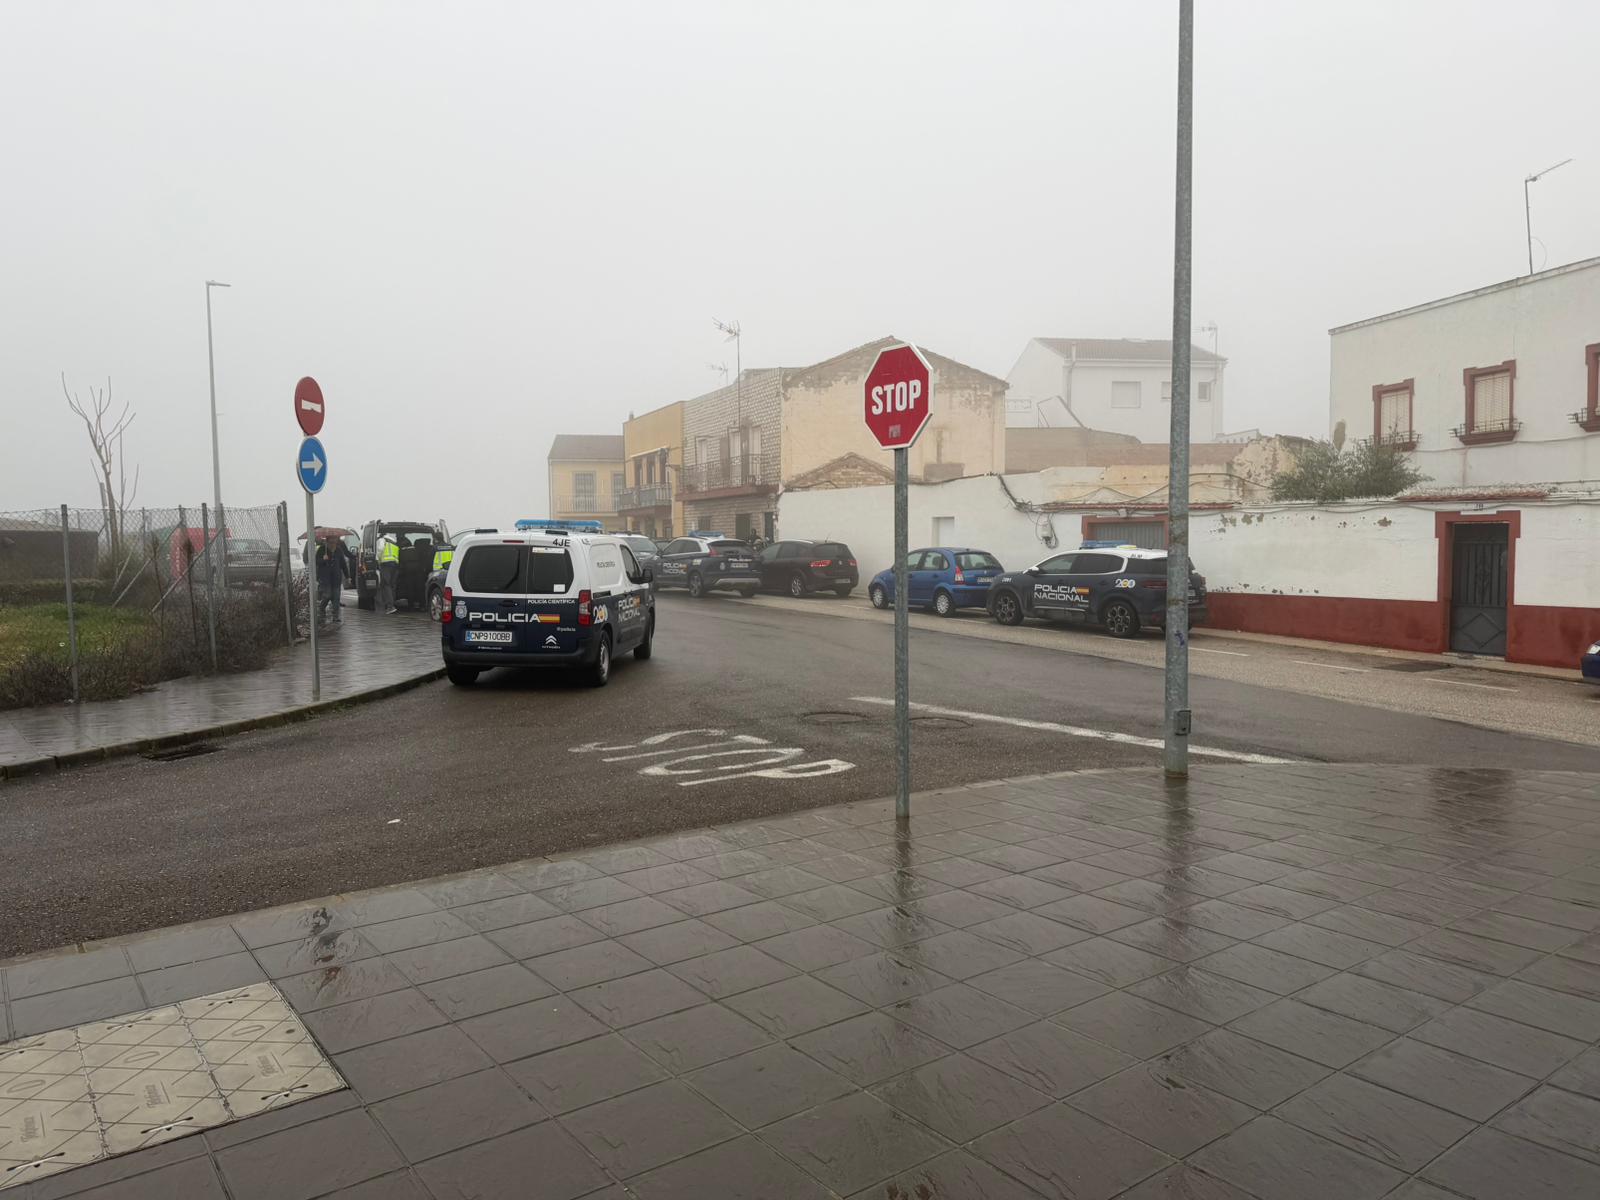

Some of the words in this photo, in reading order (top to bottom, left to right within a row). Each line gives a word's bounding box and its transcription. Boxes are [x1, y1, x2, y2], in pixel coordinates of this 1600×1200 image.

[871, 379, 922, 416] STOP
[552, 538, 571, 548] 4JE
[1033, 583, 1078, 594] POLICIA
[1034, 591, 1089, 603] NACIONAL
[469, 611, 541, 623] POLICIA
[567, 728, 857, 787] STOP
